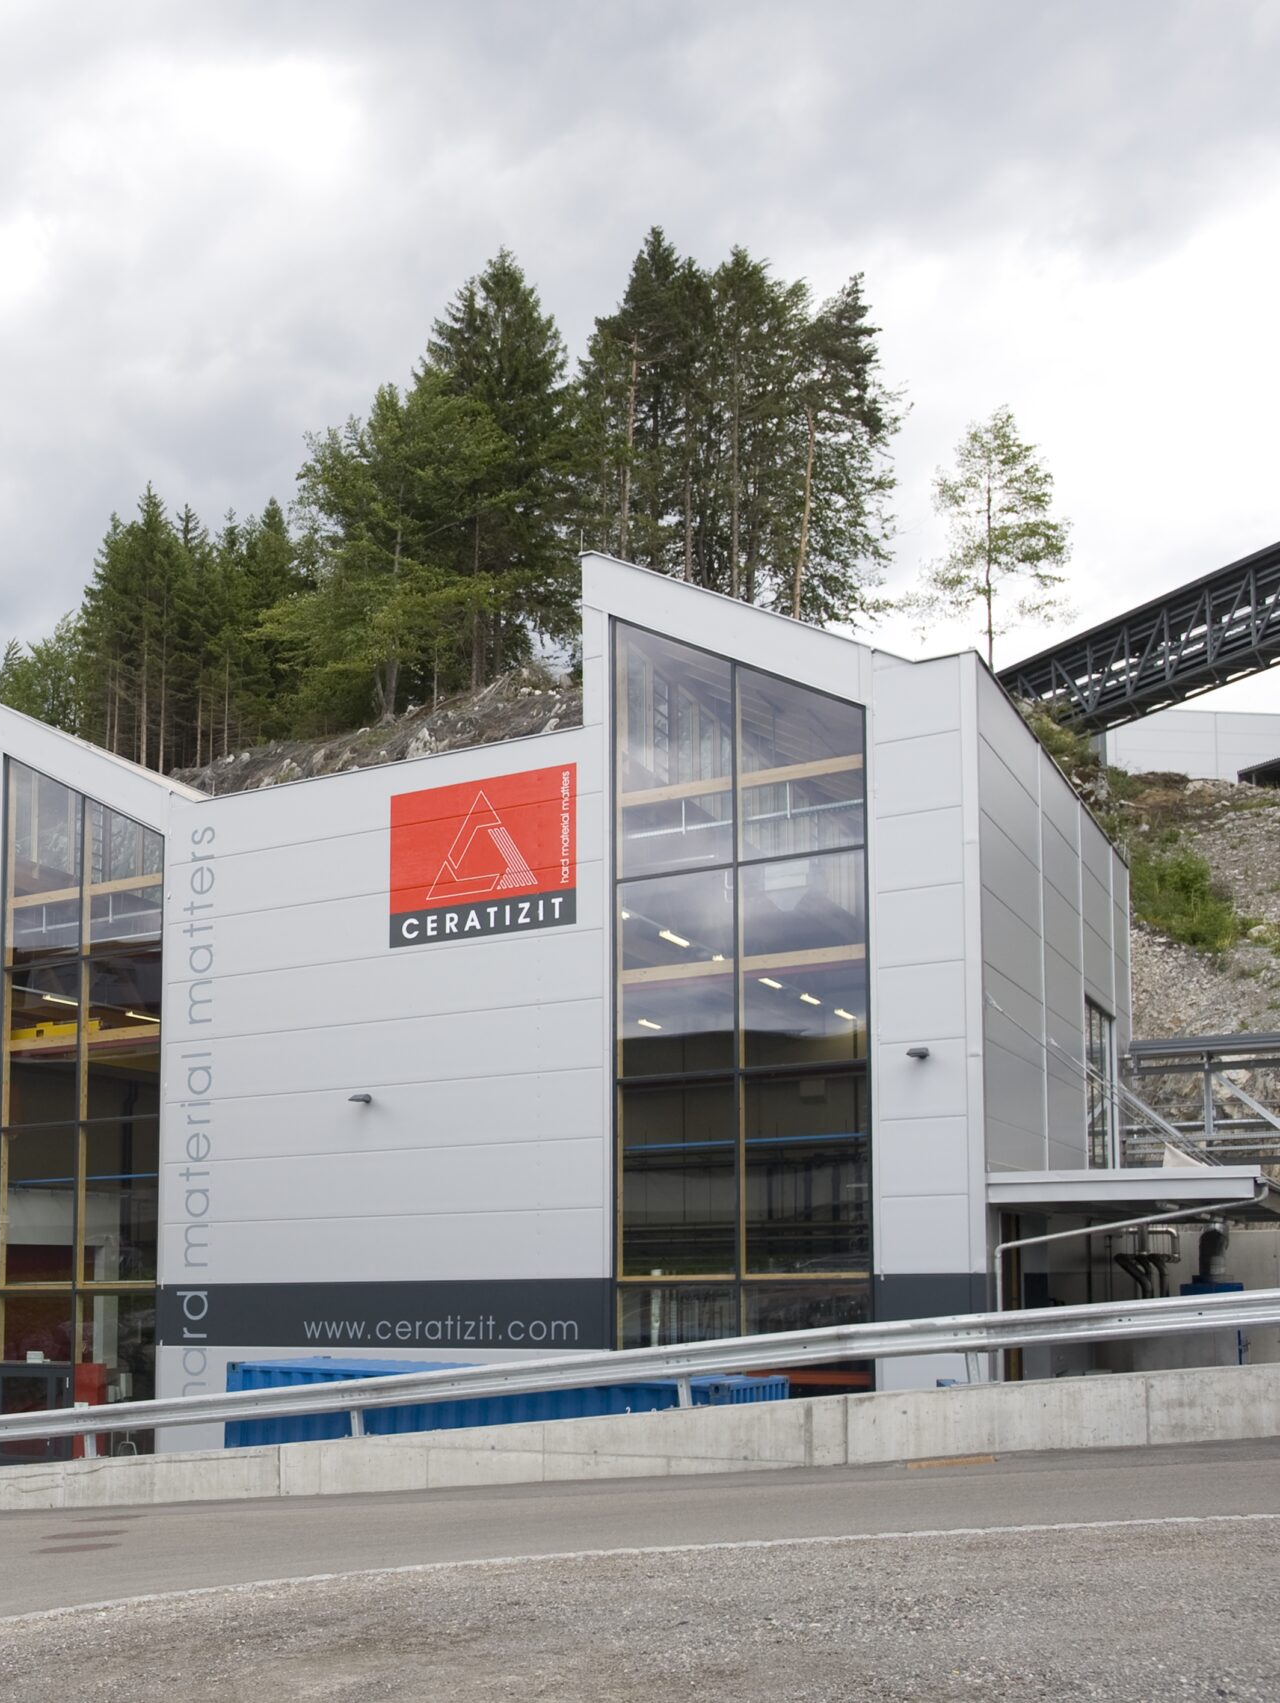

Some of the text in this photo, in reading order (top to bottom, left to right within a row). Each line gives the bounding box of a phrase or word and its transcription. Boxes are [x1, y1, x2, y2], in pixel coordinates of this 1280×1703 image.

[560, 770, 570, 884] hard material matters
[183, 825, 216, 1025] matters
[401, 897, 564, 939] CERATIZIT
[179, 1052, 212, 1268] material
[303, 1315, 578, 1341] www.ceratizit.com
